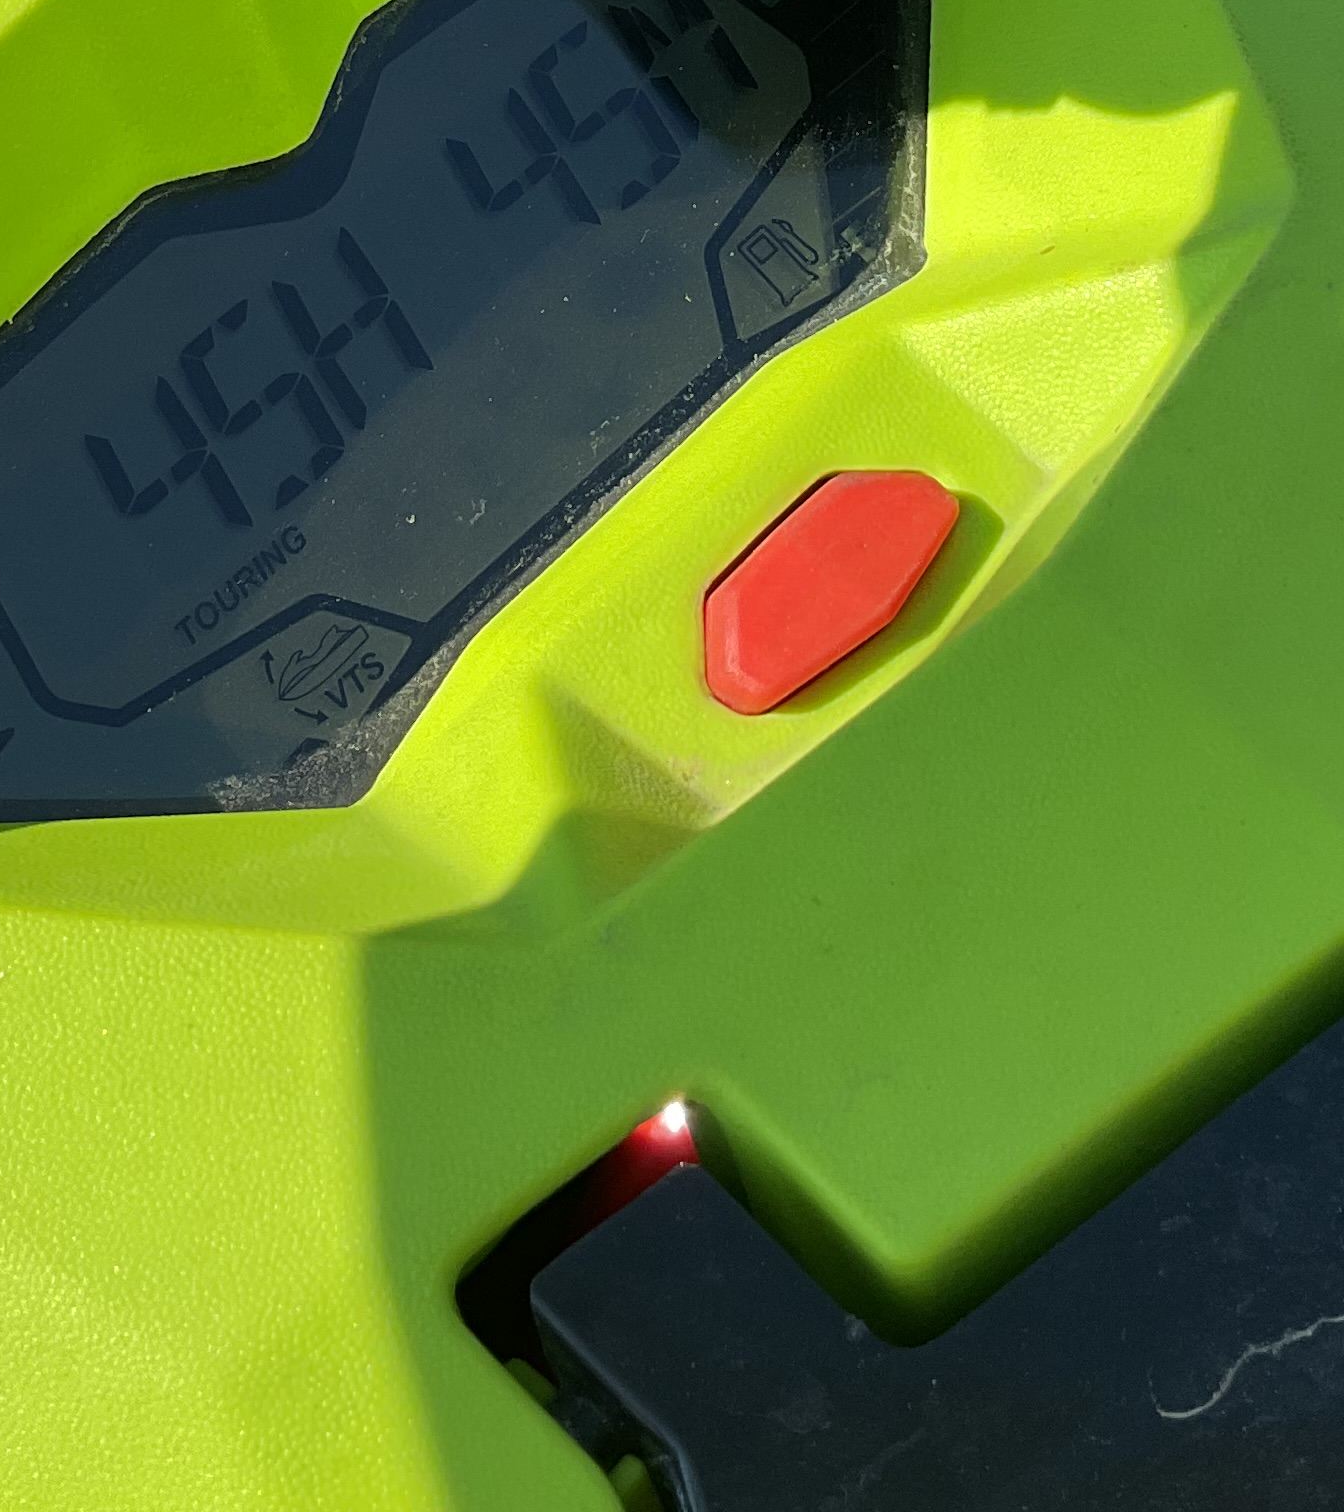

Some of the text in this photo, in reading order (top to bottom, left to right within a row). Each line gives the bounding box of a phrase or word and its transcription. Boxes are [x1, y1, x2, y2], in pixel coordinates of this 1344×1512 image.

[84, 226, 435, 528] 45H
[173, 525, 307, 645] TOURING
[324, 652, 385, 710] VTS
